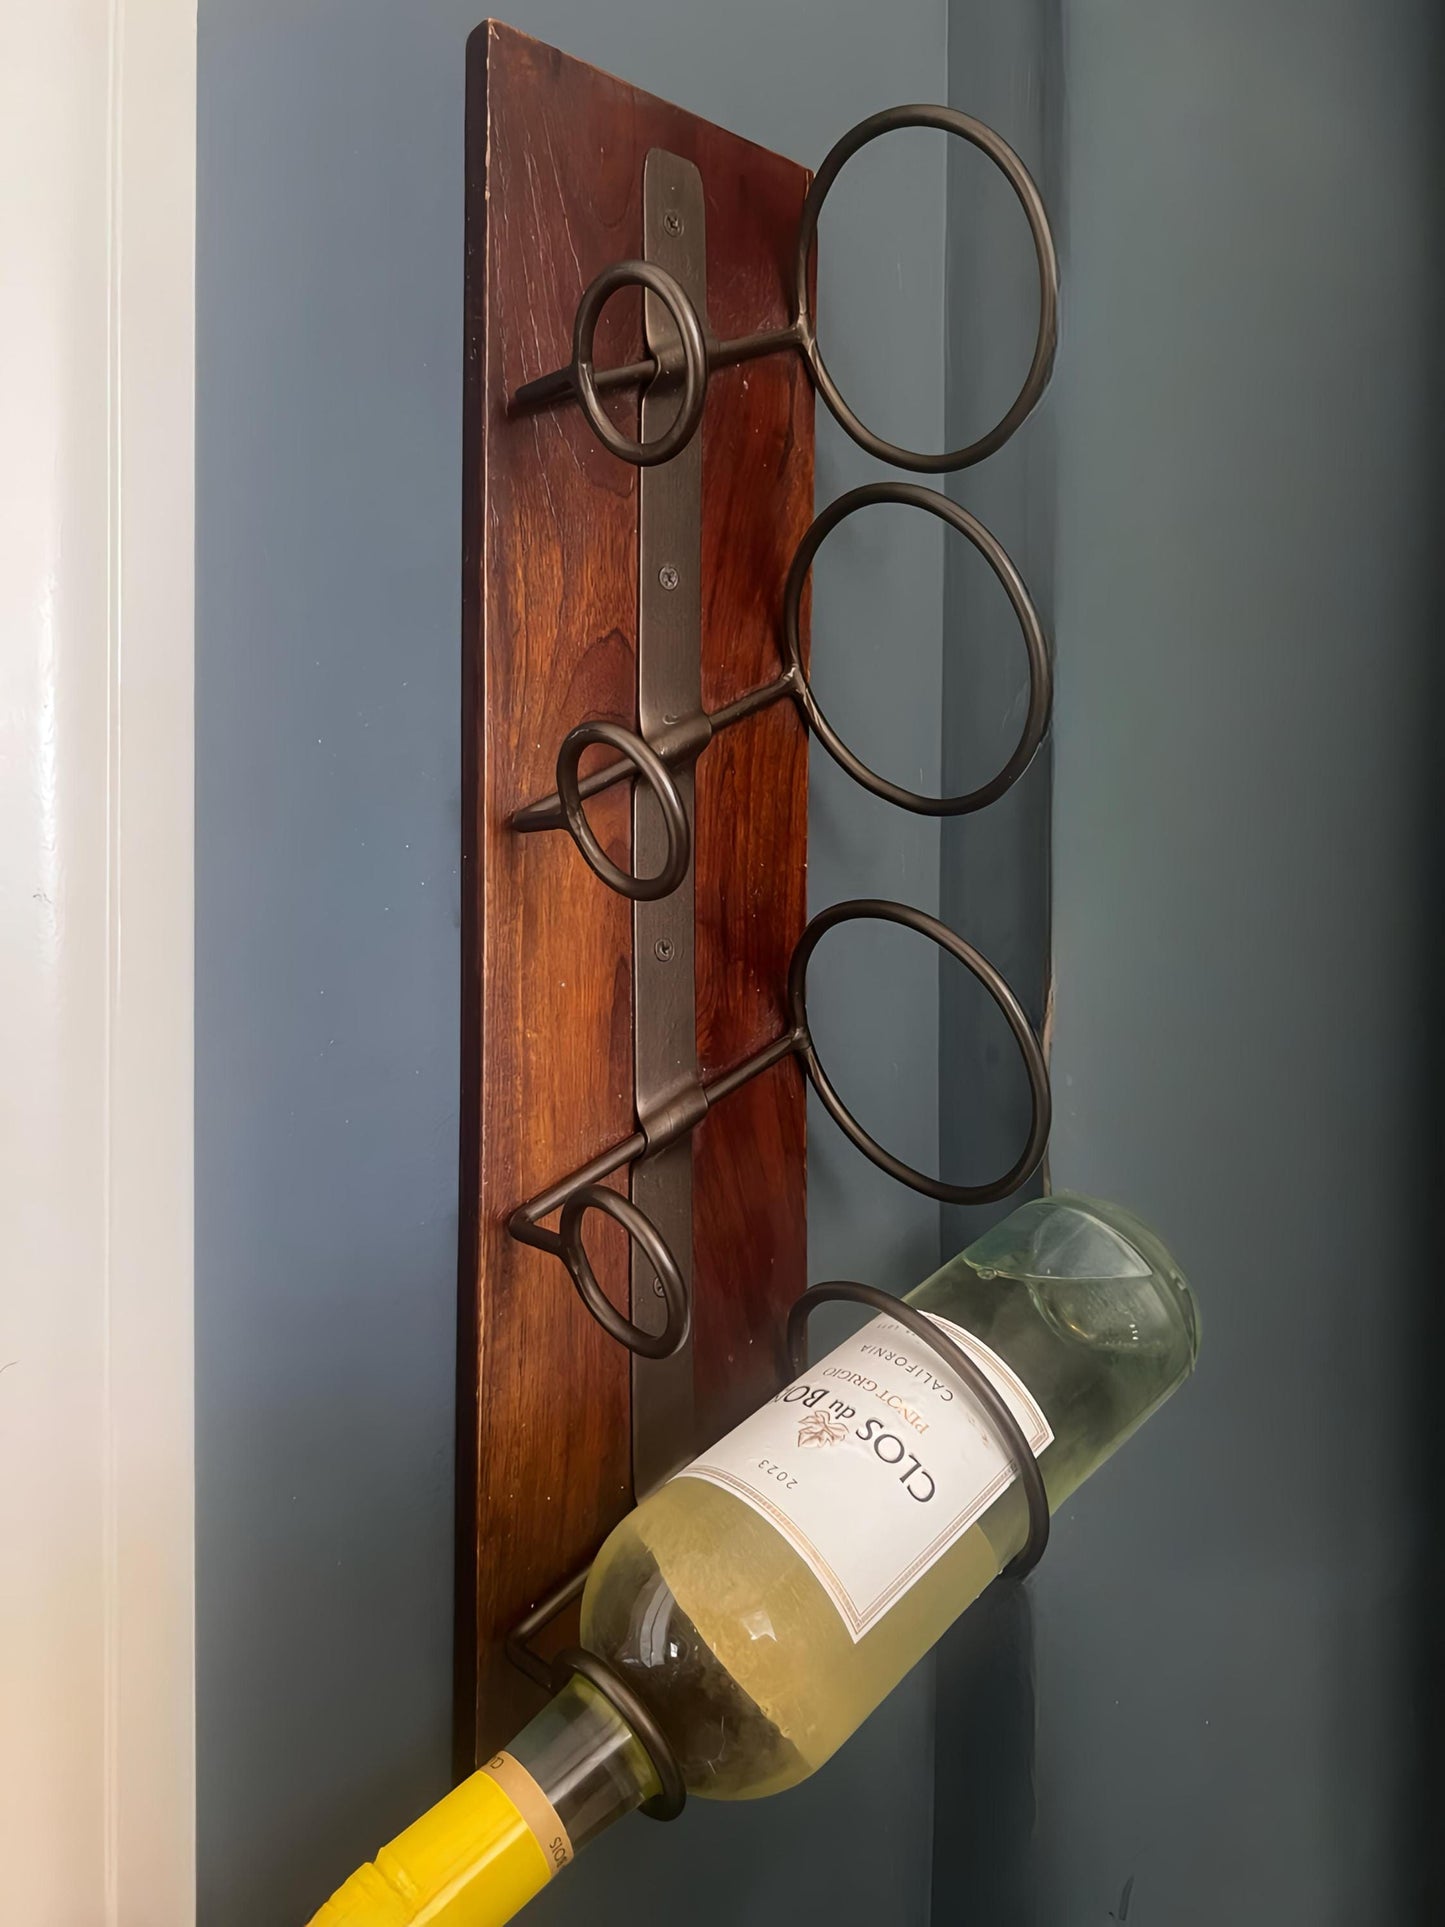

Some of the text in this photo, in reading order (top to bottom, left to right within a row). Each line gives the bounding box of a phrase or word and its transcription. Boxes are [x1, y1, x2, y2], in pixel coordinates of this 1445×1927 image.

[822, 1367, 878, 1392] GRIGIO
[860, 1344, 954, 1402] CALIFORNIA
[828, 1399, 856, 1420] du
[757, 1459, 798, 1490] 2023
[855, 1418, 936, 1503] CLOS
